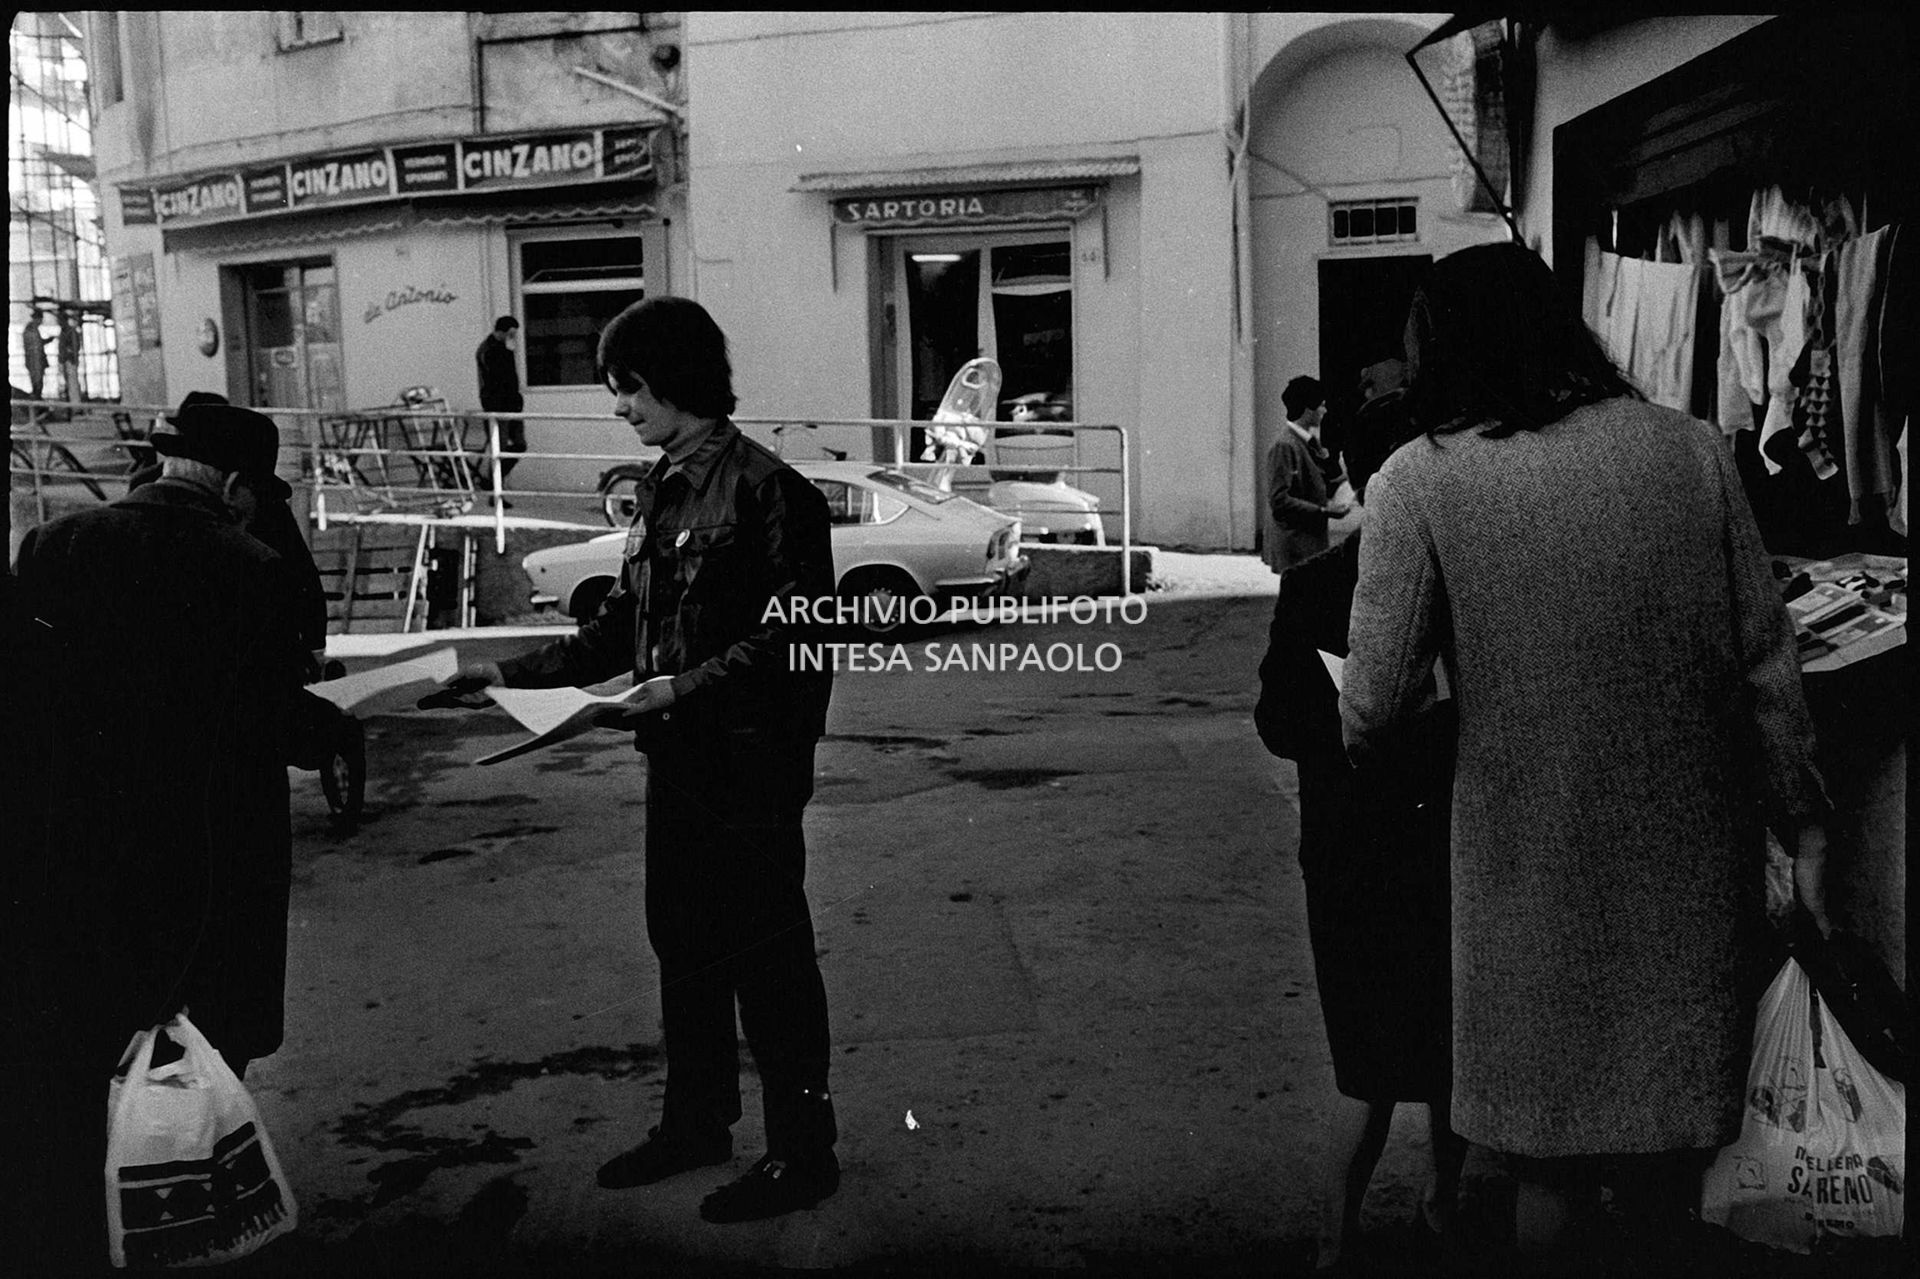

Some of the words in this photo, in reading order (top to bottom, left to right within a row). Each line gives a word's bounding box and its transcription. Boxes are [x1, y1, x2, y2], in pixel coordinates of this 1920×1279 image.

[463, 141, 595, 178] CINZANO
[292, 160, 388, 196] CINZANO
[159, 181, 238, 216] CINZANO
[847, 197, 984, 221] SARTORIA
